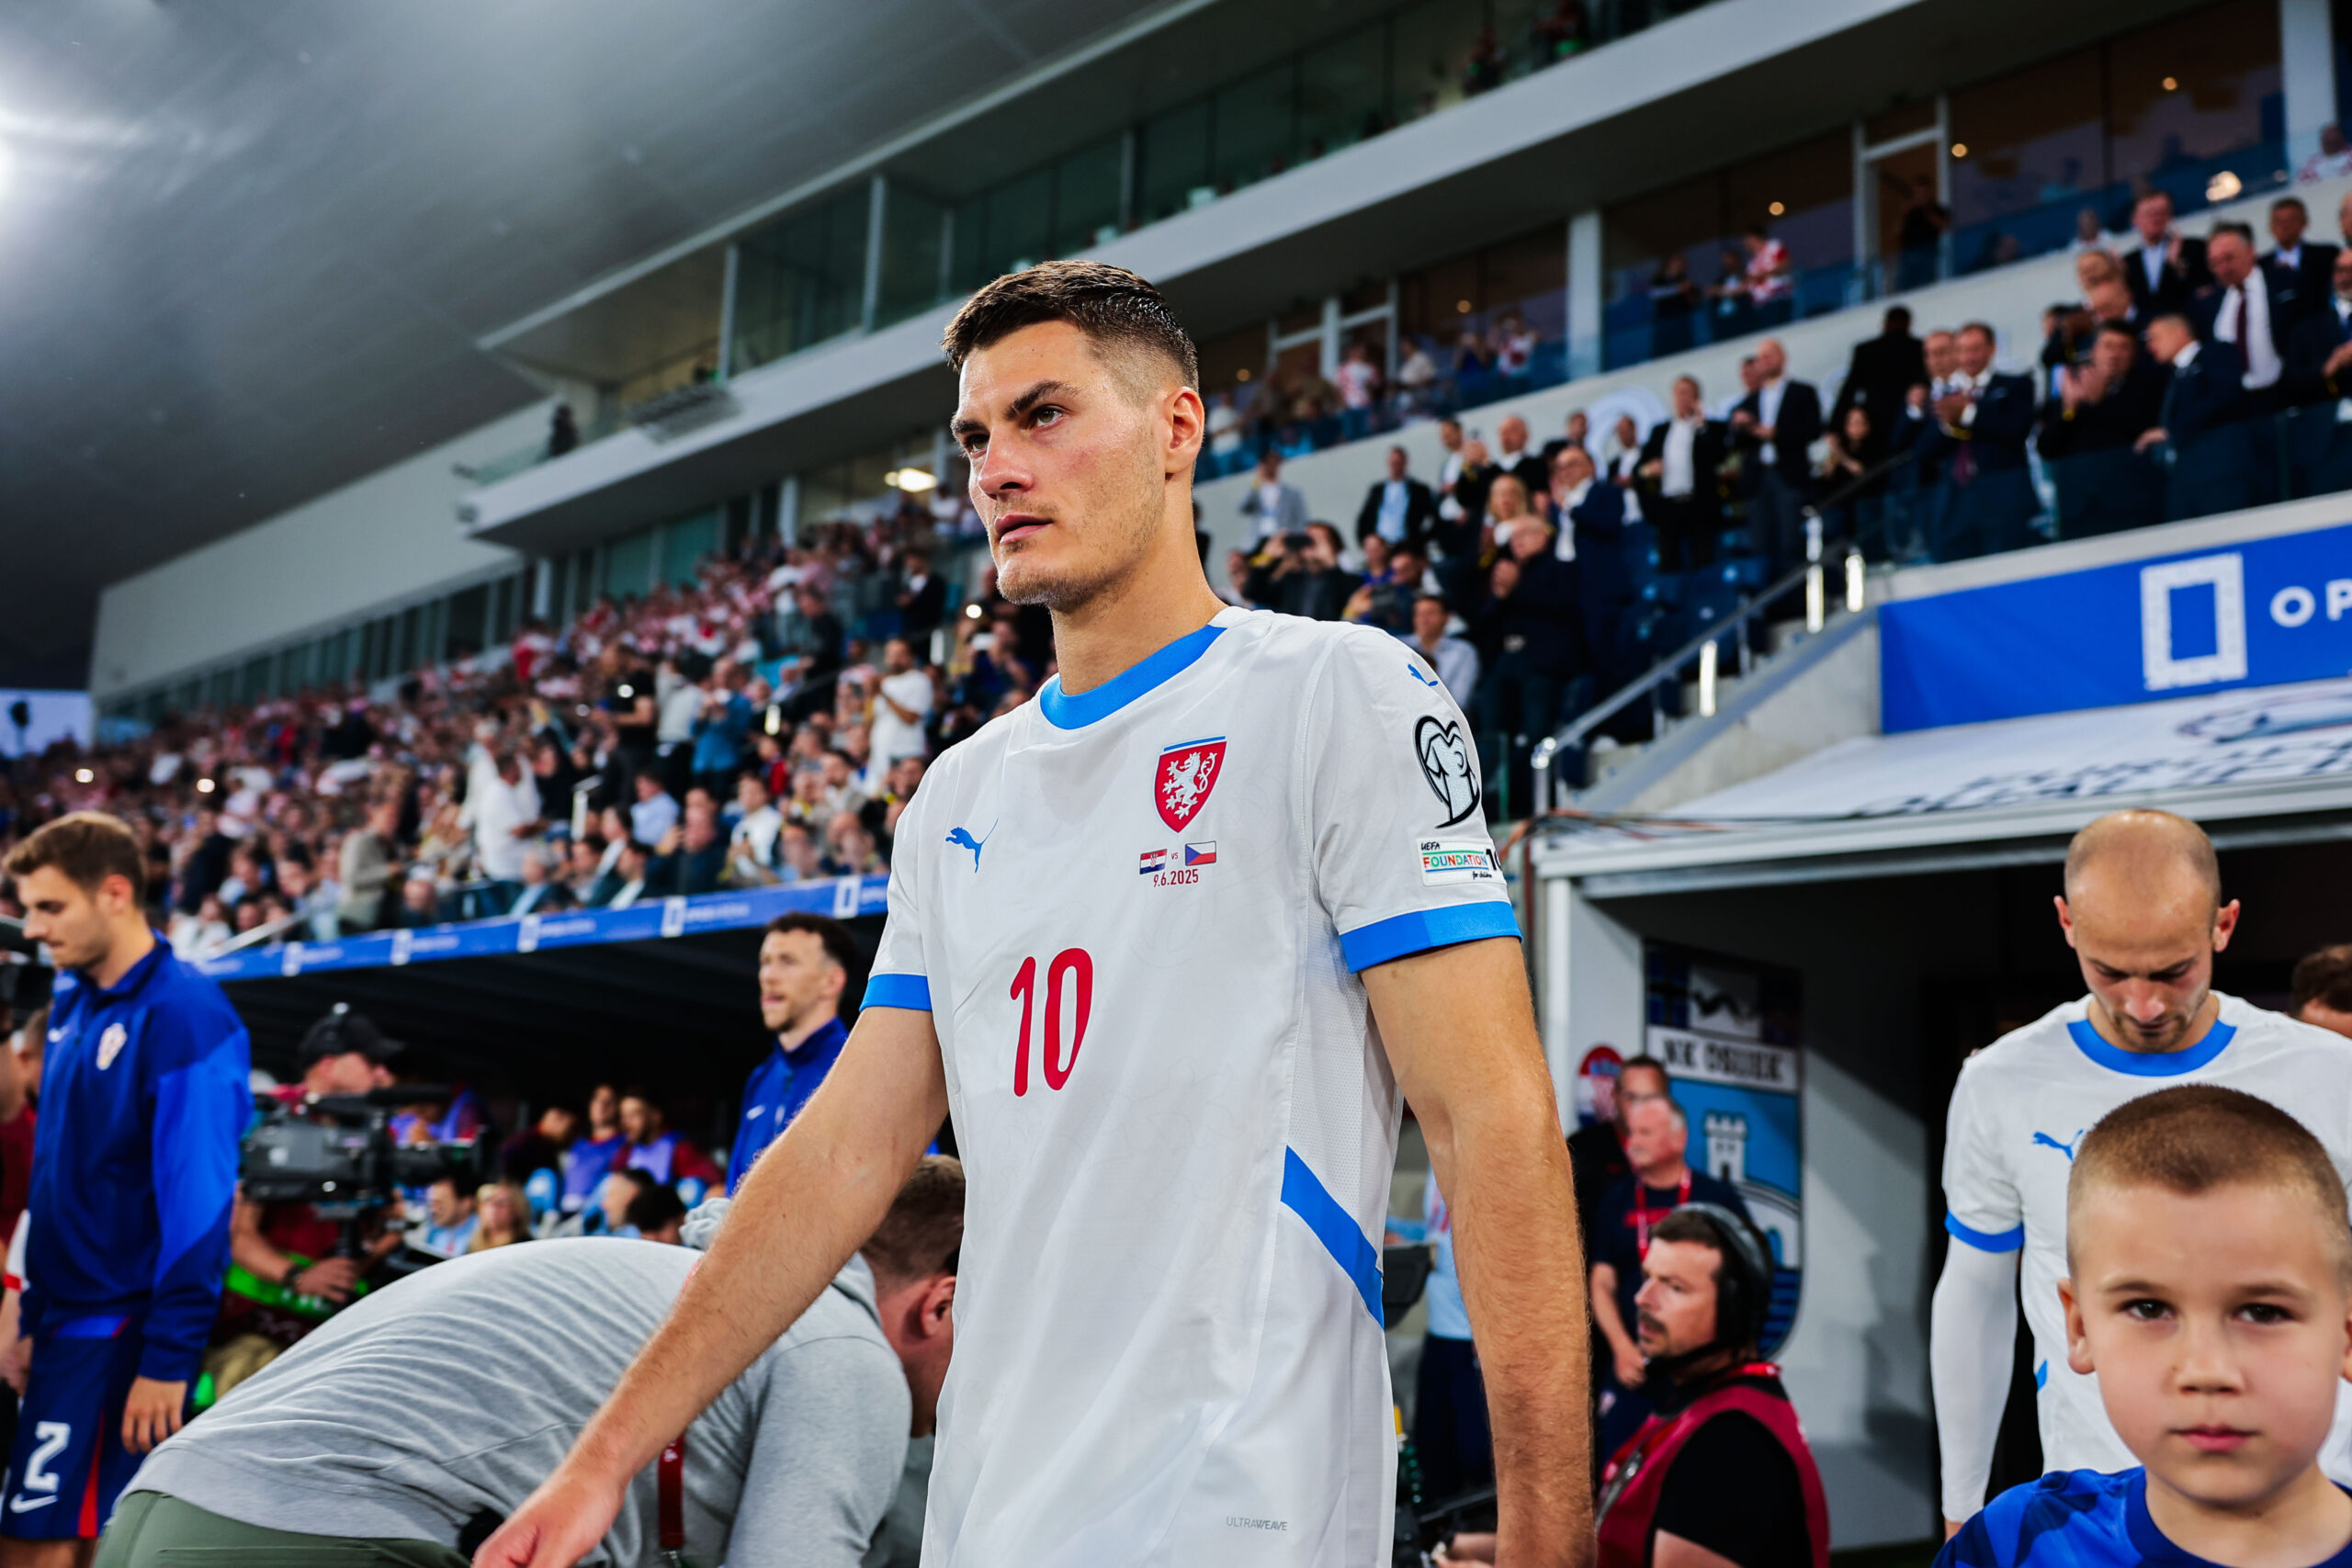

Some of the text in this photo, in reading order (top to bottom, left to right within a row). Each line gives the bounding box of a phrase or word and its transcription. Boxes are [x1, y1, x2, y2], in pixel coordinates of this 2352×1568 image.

[1420, 841, 1441, 851] UEFA
[1423, 854, 1487, 869] FOUNDATION
[1153, 868, 1199, 888] 9.6.2025
[1010, 947, 1093, 1097] 10
[23, 1420, 72, 1494] 2
[1226, 1516, 1288, 1531] ULTRAWEAVE
